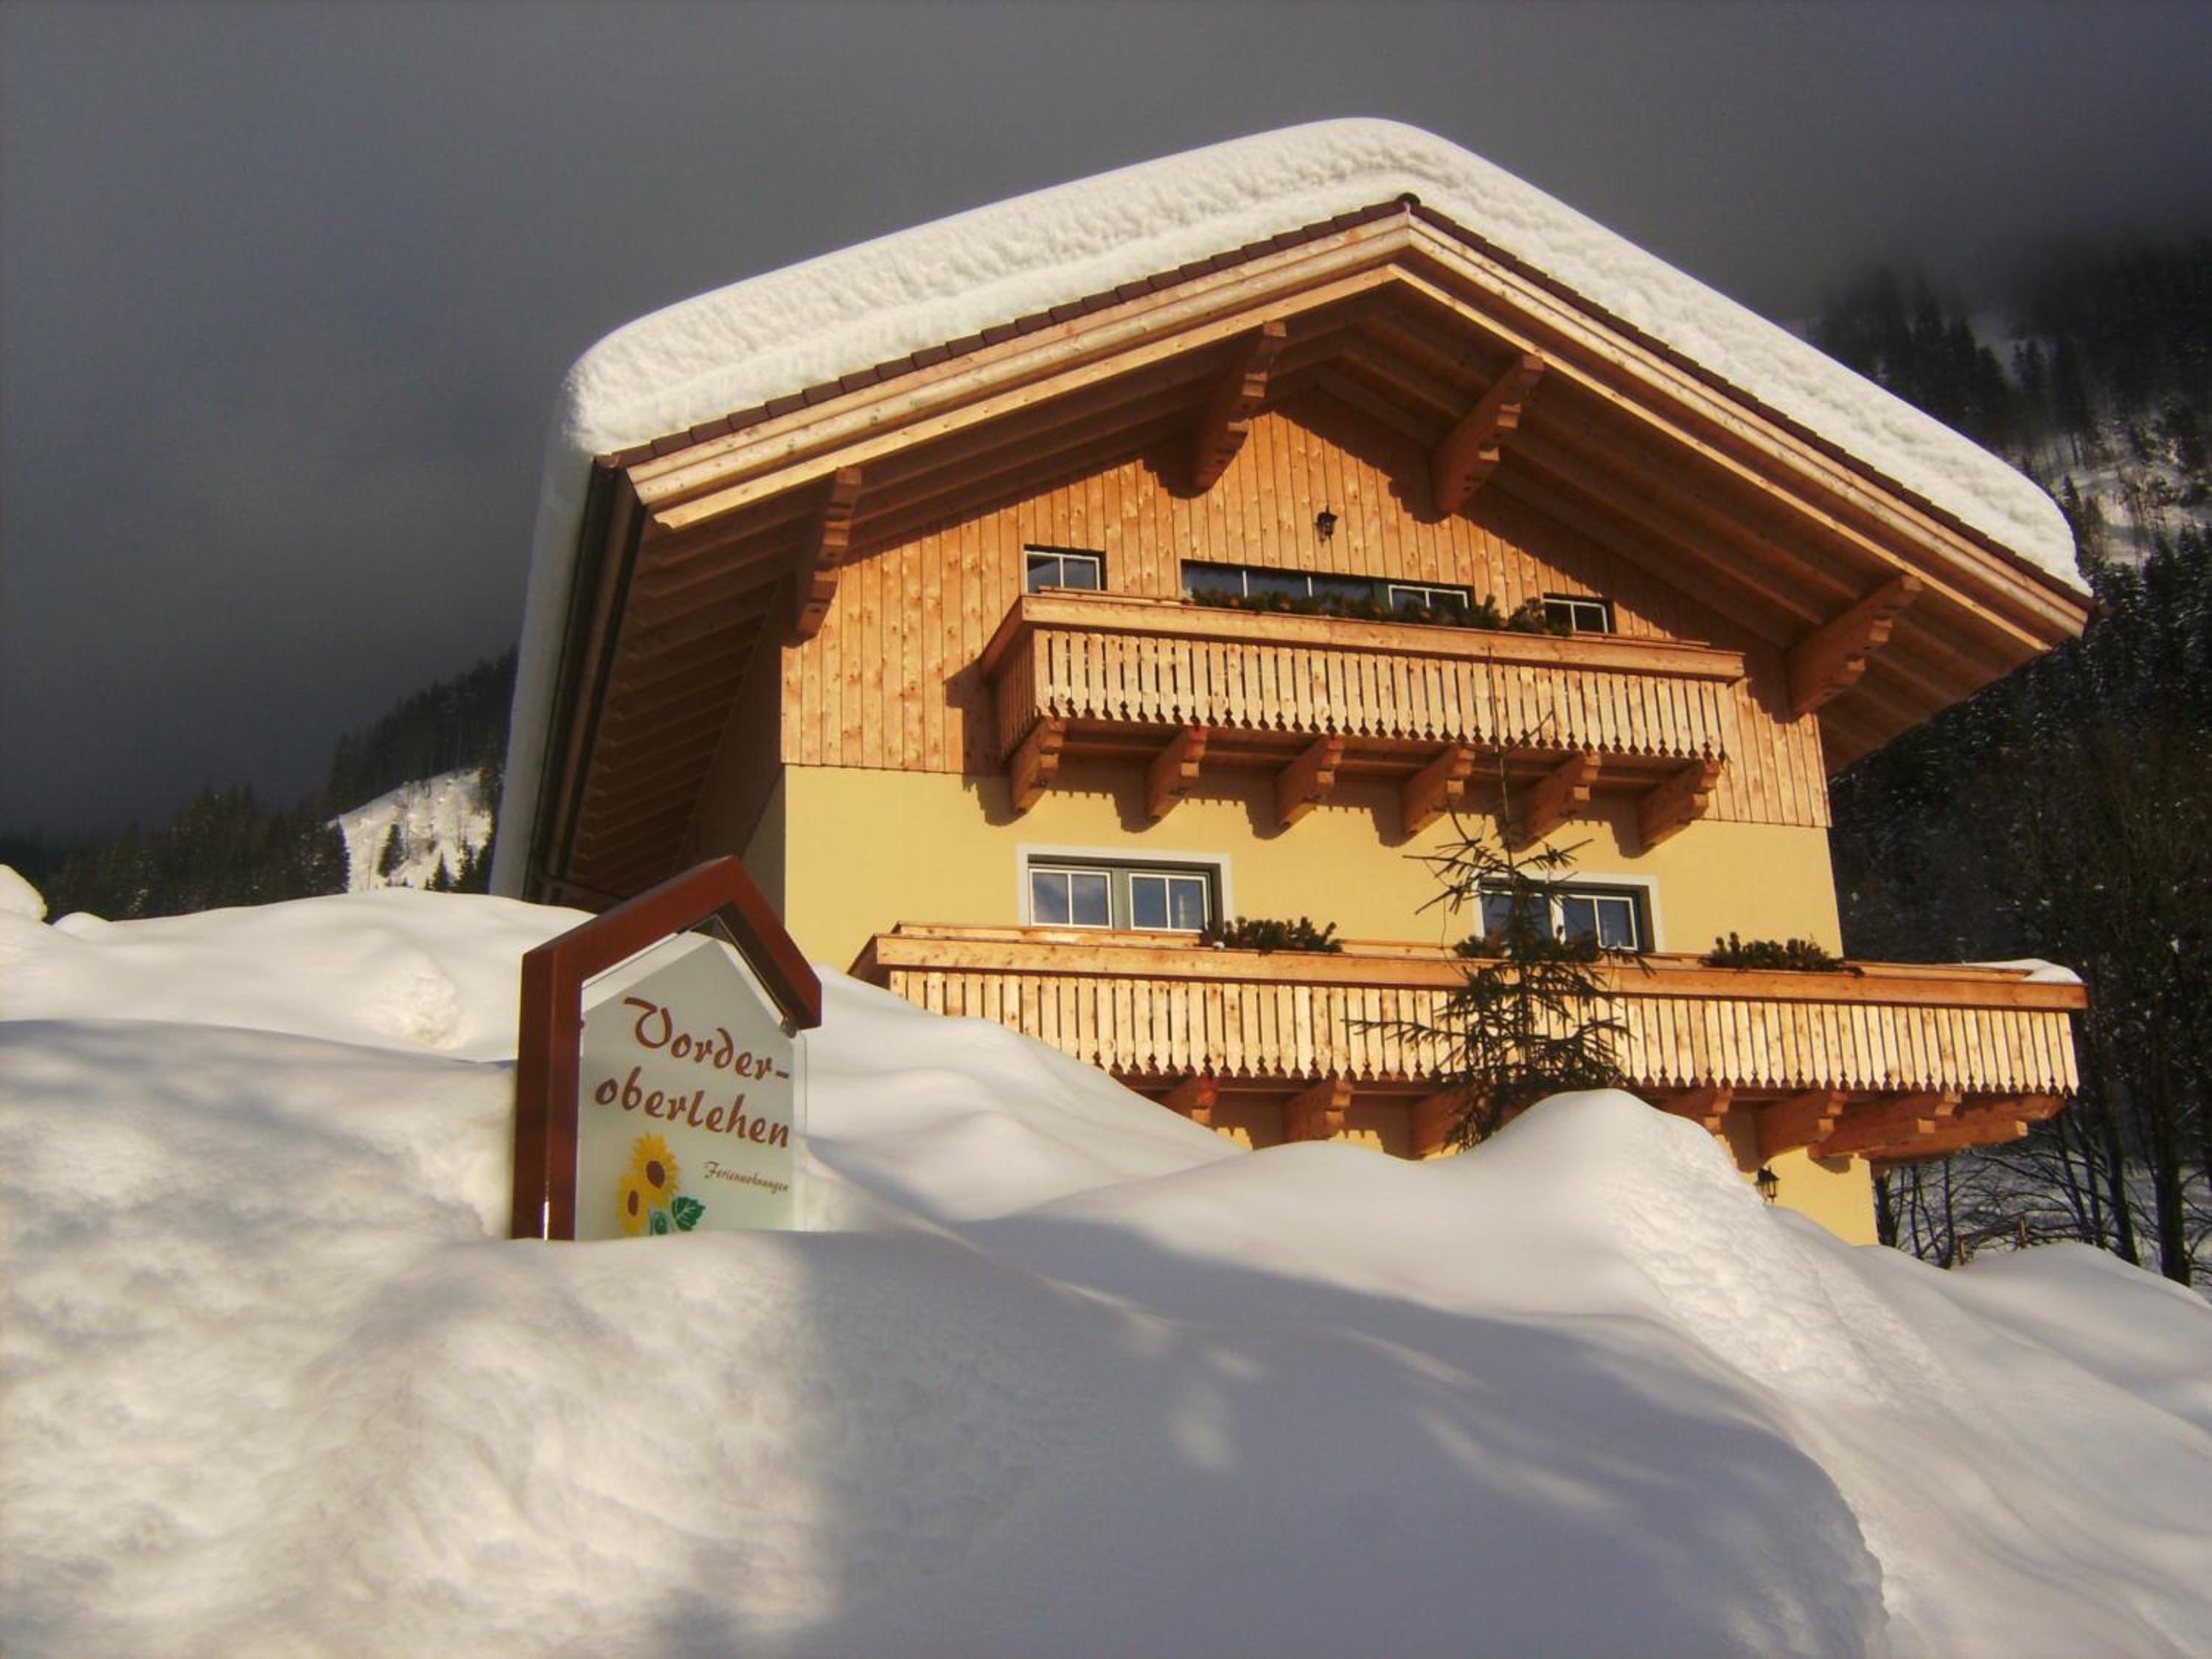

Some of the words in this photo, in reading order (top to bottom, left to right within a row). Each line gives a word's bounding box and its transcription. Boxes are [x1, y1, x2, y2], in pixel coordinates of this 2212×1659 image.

[624, 997, 790, 1080] Vorder-
[595, 1066, 789, 1147] oberlehen
[704, 1161, 790, 1193] Ferienwohnungen
